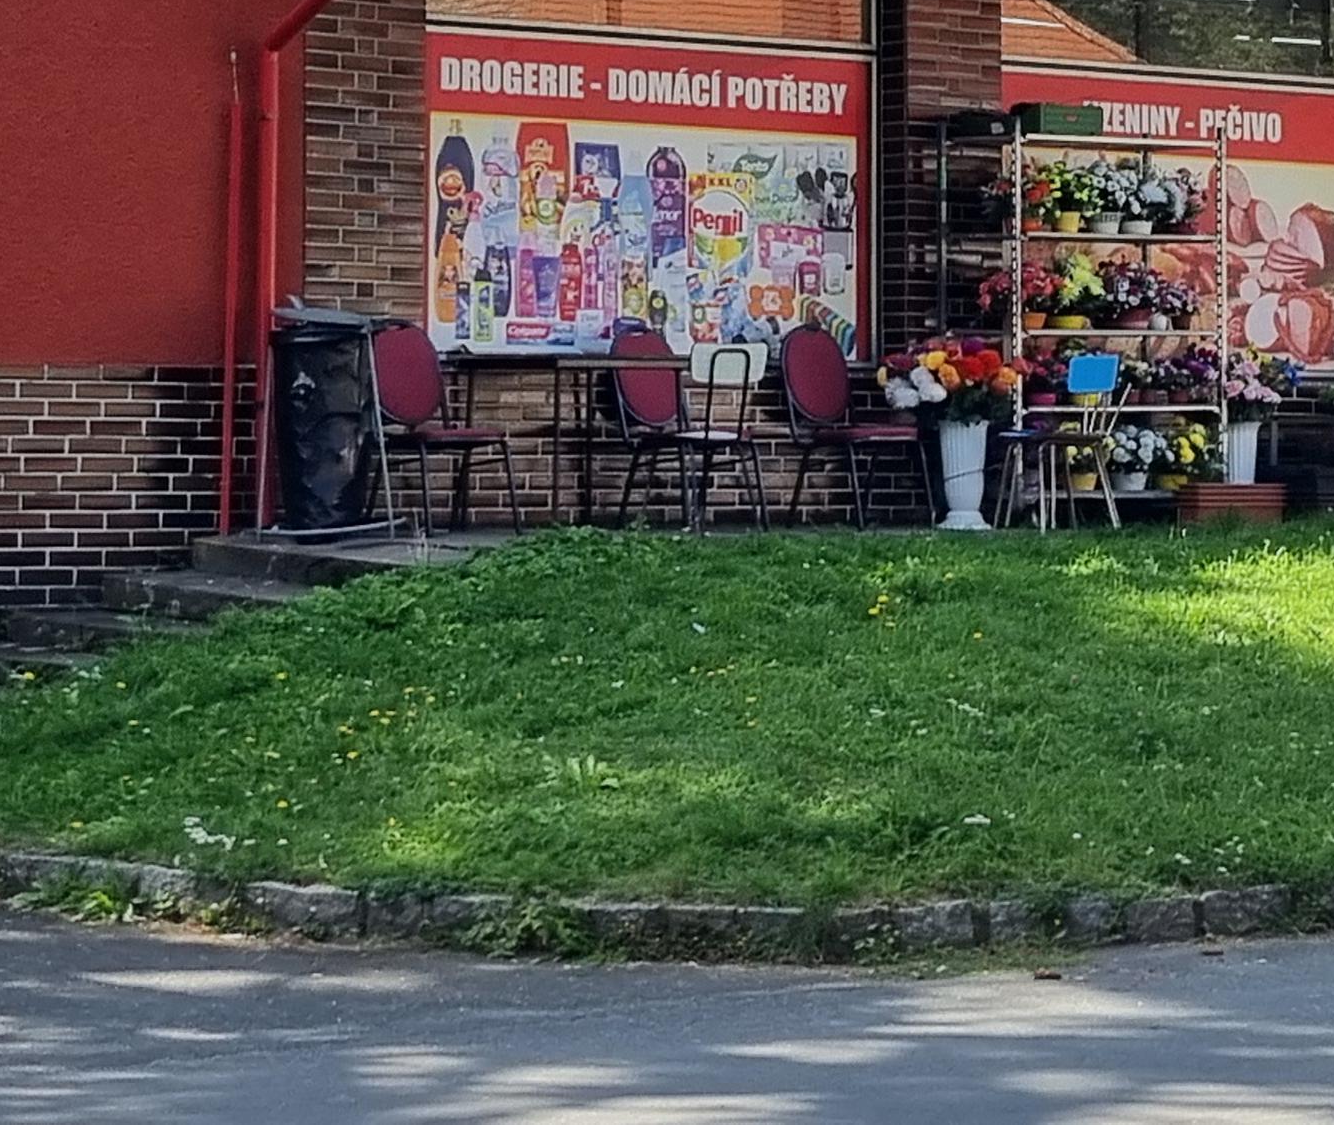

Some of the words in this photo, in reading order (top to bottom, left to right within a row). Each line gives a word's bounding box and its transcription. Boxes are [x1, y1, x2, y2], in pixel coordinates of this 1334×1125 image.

[440, 56, 585, 99] DROGERIE
[589, 82, 602, 90] -
[608, 66, 722, 107] DOMÁCÍ
[727, 73, 848, 116] POTŘEBY
[1083, 100, 1181, 137] ZENINY
